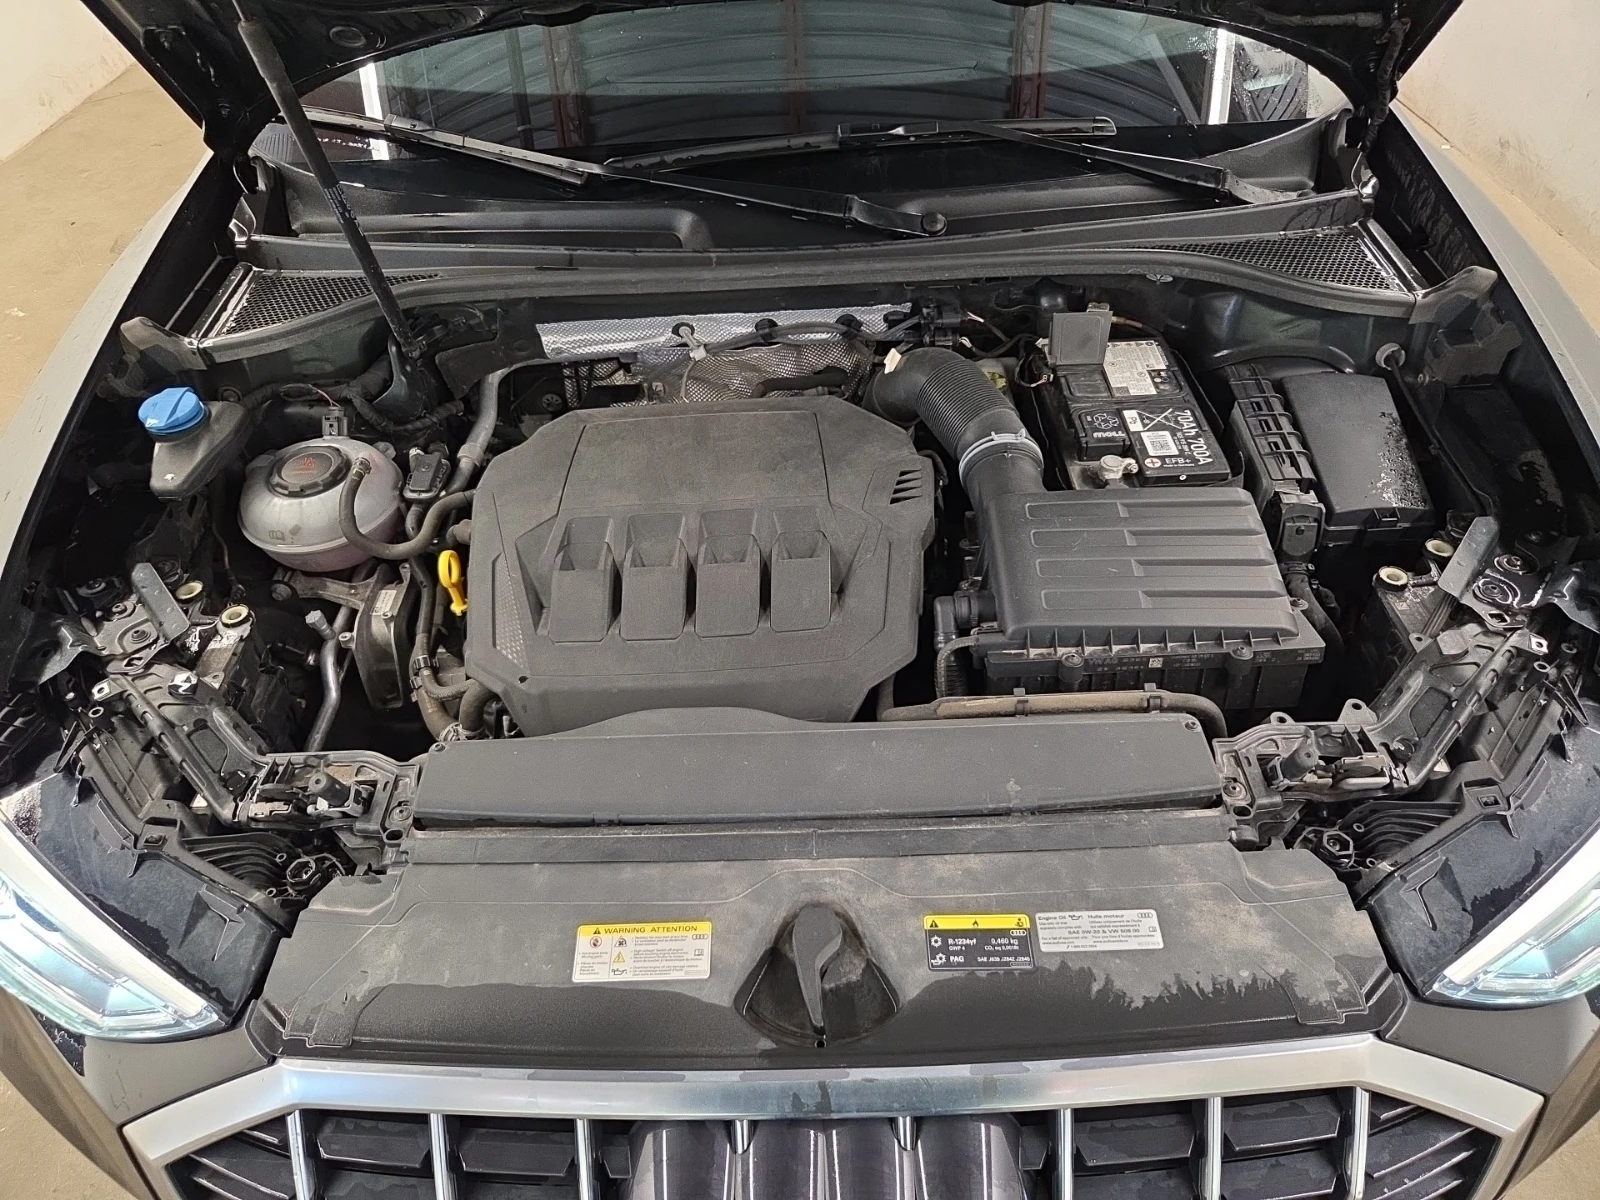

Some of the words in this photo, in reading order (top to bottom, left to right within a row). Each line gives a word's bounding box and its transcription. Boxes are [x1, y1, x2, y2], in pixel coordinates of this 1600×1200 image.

[1175, 410, 1199, 436] 70Ah
[1187, 438, 1214, 465] 700A
[604, 926, 646, 934] WARNING
